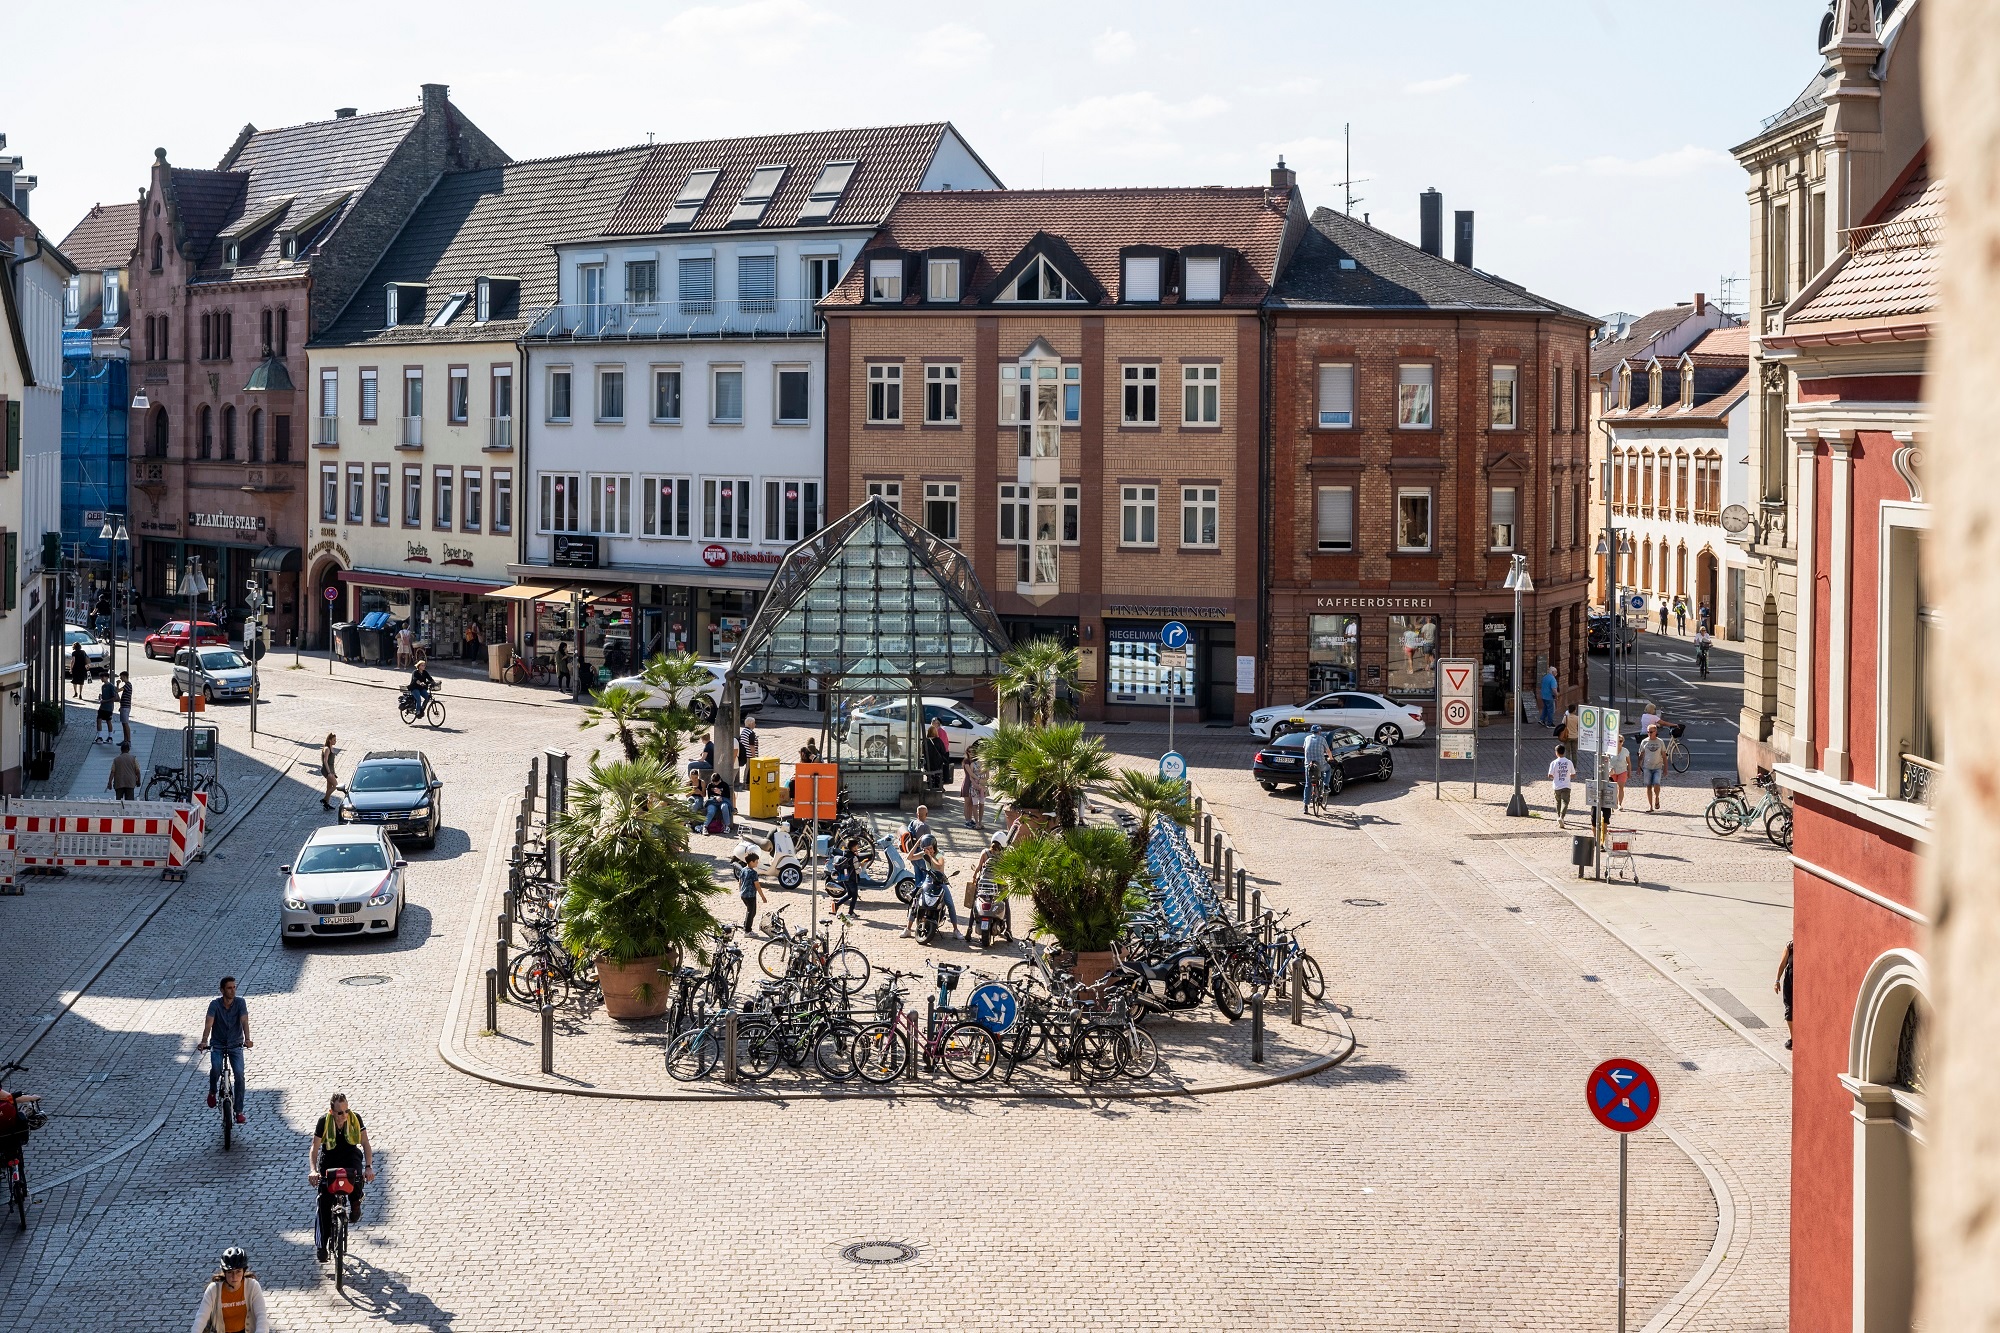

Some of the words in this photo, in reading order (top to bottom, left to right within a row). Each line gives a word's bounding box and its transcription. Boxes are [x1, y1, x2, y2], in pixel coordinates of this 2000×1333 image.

[195, 510, 234, 528] FLAMING
[235, 516, 257, 530] STAR
[731, 551, 783, 564] Reisebüro
[1317, 597, 1432, 607] KAFFEERÖSTEREI
[1109, 604, 1227, 618] FINANZIERUNGEN
[1450, 706, 1466, 718] 30
